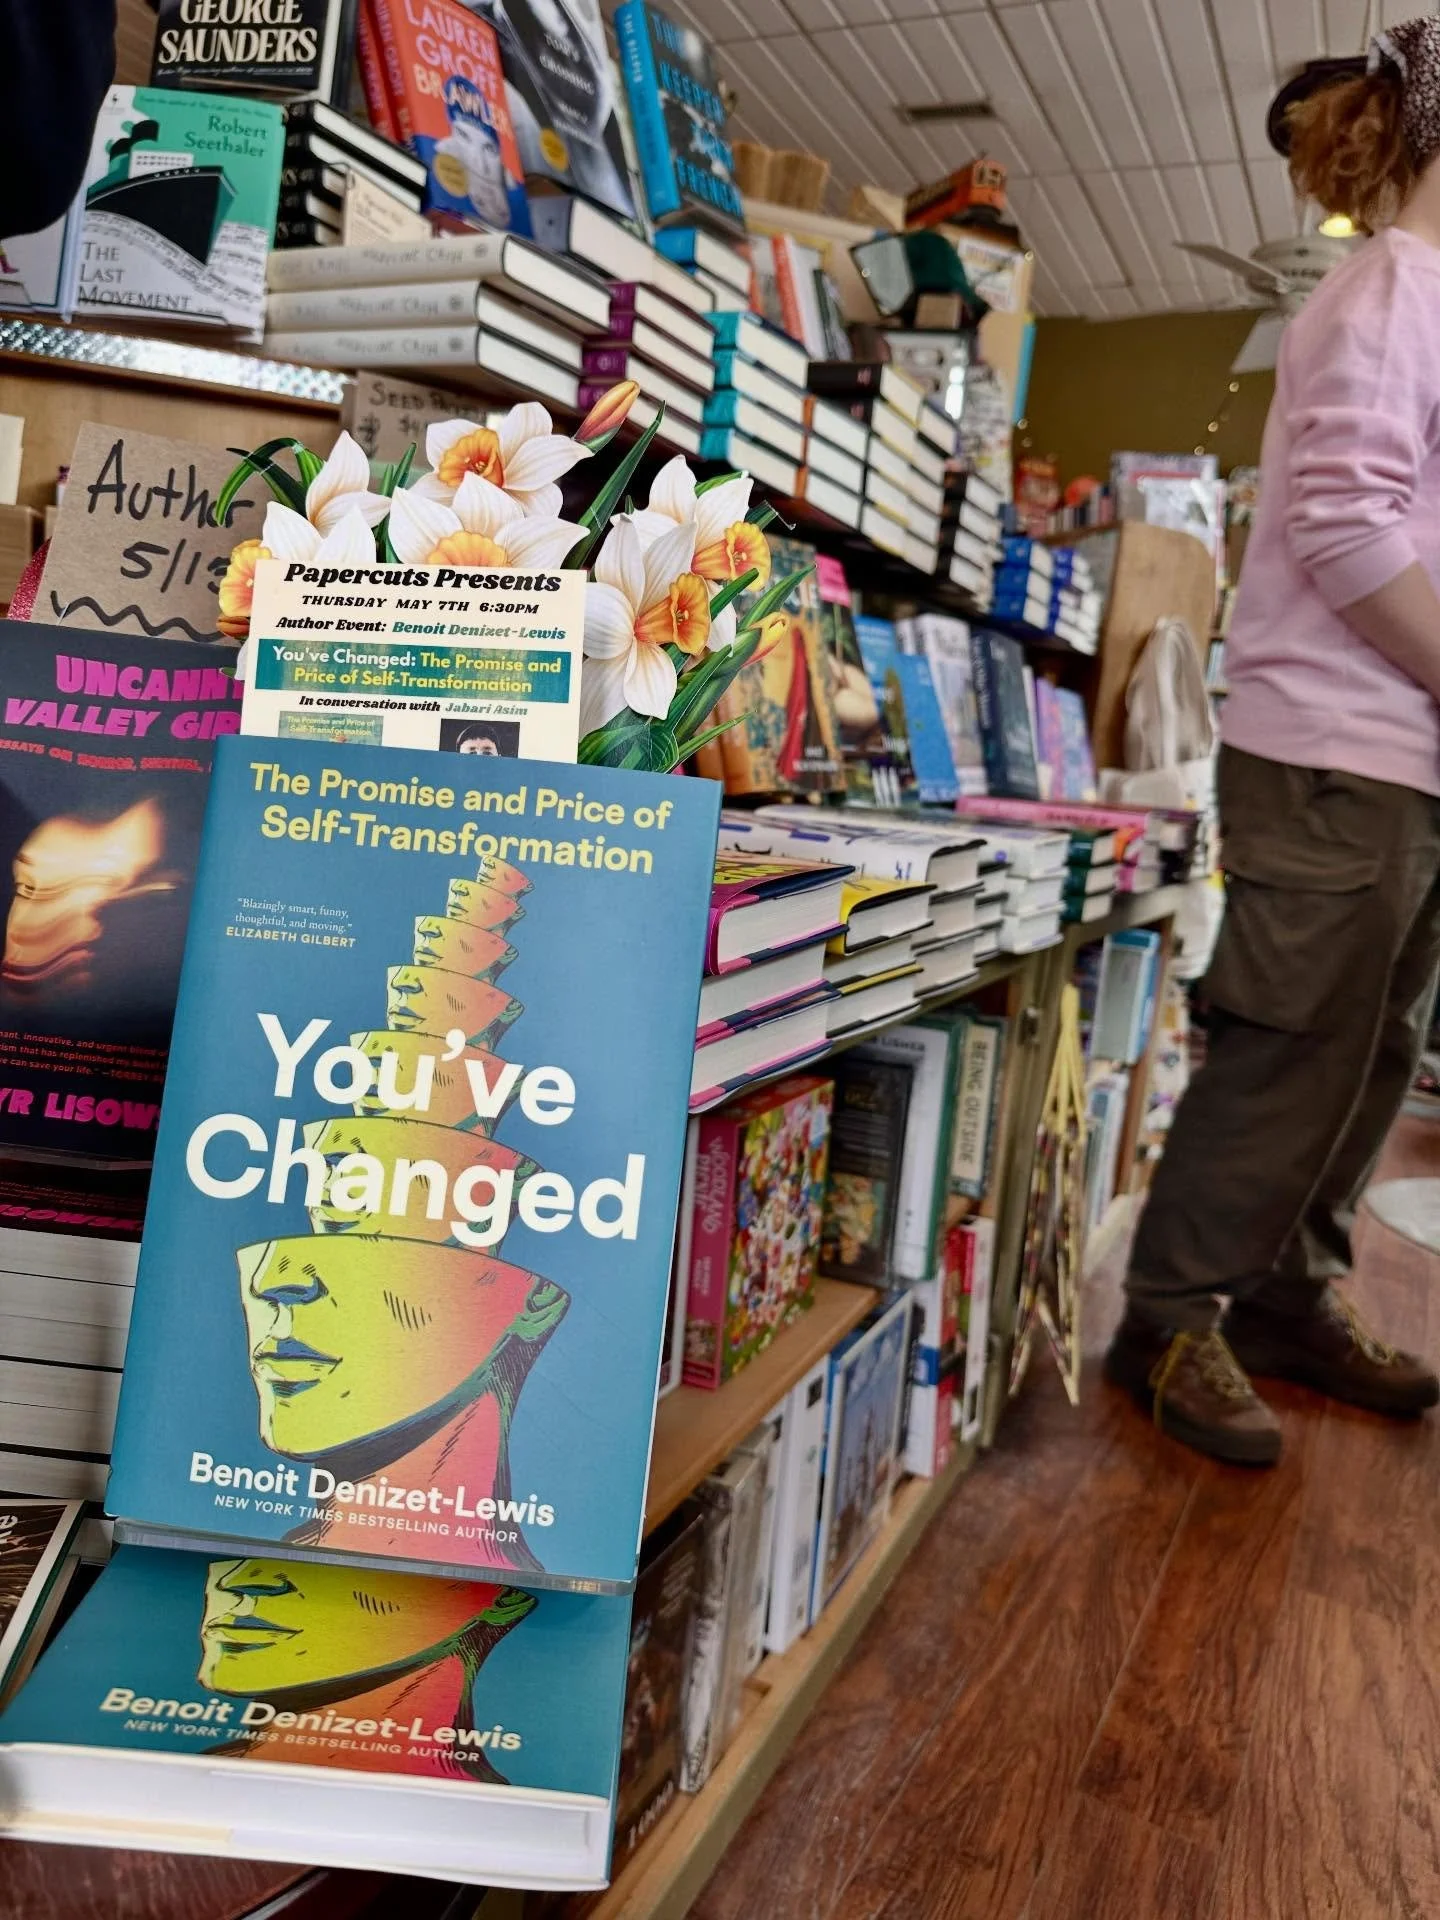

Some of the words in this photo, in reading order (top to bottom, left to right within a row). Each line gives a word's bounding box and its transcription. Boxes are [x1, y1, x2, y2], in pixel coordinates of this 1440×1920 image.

[180, 0, 303, 24] GEORGE
[158, 28, 318, 64] SAUNDERS
[404, 0, 497, 66] LAUREN
[414, 34, 497, 97] GROFF
[207, 114, 268, 139] Robert
[183, 131, 265, 158] Seethaler
[82, 241, 120, 262] THE
[79, 263, 126, 284] LAST
[77, 285, 193, 310] MOVEMENT
[88, 439, 255, 528] Author
[284, 563, 430, 587] Papercuts
[433, 568, 562, 591] Presents
[302, 595, 387, 608] THURSDAY
[395, 599, 433, 610] MAY
[438, 600, 470, 612] 7TH
[479, 602, 539, 614] 6:30PM
[276, 616, 334, 630] Author
[335, 619, 387, 632] Event:
[392, 622, 446, 635] Benoit
[448, 624, 566, 640] Denizet-Lewis
[273, 645, 330, 663] You've
[333, 648, 416, 670] Changed:
[420, 652, 451, 668] The
[456, 653, 524, 671] Promise
[527, 658, 562, 673] and
[294, 667, 336, 684] Price
[340, 669, 358, 684] of
[361, 670, 532, 693] Self-Transformation
[5, 698, 161, 737] VALLEY
[299, 695, 314, 706] In
[316, 697, 407, 710] conversation
[409, 700, 441, 712] with
[445, 702, 492, 714] Jabari
[493, 705, 528, 716] Asim
[250, 762, 311, 796] The
[319, 765, 455, 809] Promise
[463, 785, 527, 816] and
[535, 788, 626, 829] Price
[634, 800, 673, 831] of
[260, 804, 654, 874] Self-Transformation
[235, 912, 287, 928] thoughtful,
[289, 919, 307, 929] and
[238, 897, 286, 914] “Blazingly
[288, 904, 317, 916] smart,
[320, 905, 349, 920] funny,
[226, 926, 298, 942] ELIZABETH
[300, 933, 356, 948] GILBERT
[20, 1046, 39, 1055] that
[41, 1048, 57, 1058] has
[23, 1032, 74, 1047] innovative,
[76, 1040, 94, 1049] and
[10, 1059, 27, 1067] can
[30, 1061, 51, 1070] save
[53, 1064, 75, 1073] your
[256, 1012, 577, 1126] You’ve
[967, 1040, 988, 1090] BEING
[44, 1092, 161, 1130] LISOW
[959, 1096, 981, 1164] OUTSIDE
[185, 1112, 646, 1248] Changed
[703, 1136, 730, 1235] WOODLAND
[188, 1451, 299, 1499] Benoit
[308, 1468, 556, 1528] Denizet-Lewis
[213, 1493, 248, 1511] NEW
[253, 1498, 294, 1517] YORK
[299, 1504, 343, 1524] TIMES
[348, 1511, 450, 1537] BESTSELLING
[454, 1526, 518, 1545] AUTHOR
[99, 1687, 234, 1725] Benoit
[240, 1700, 523, 1752] Denizet-Lewis
[123, 1718, 167, 1733] NEW
[172, 1722, 219, 1738] YORK
[226, 1728, 279, 1743] TIMES
[283, 1732, 402, 1756] BESTSELLING
[406, 1745, 481, 1763] AUTHOR
